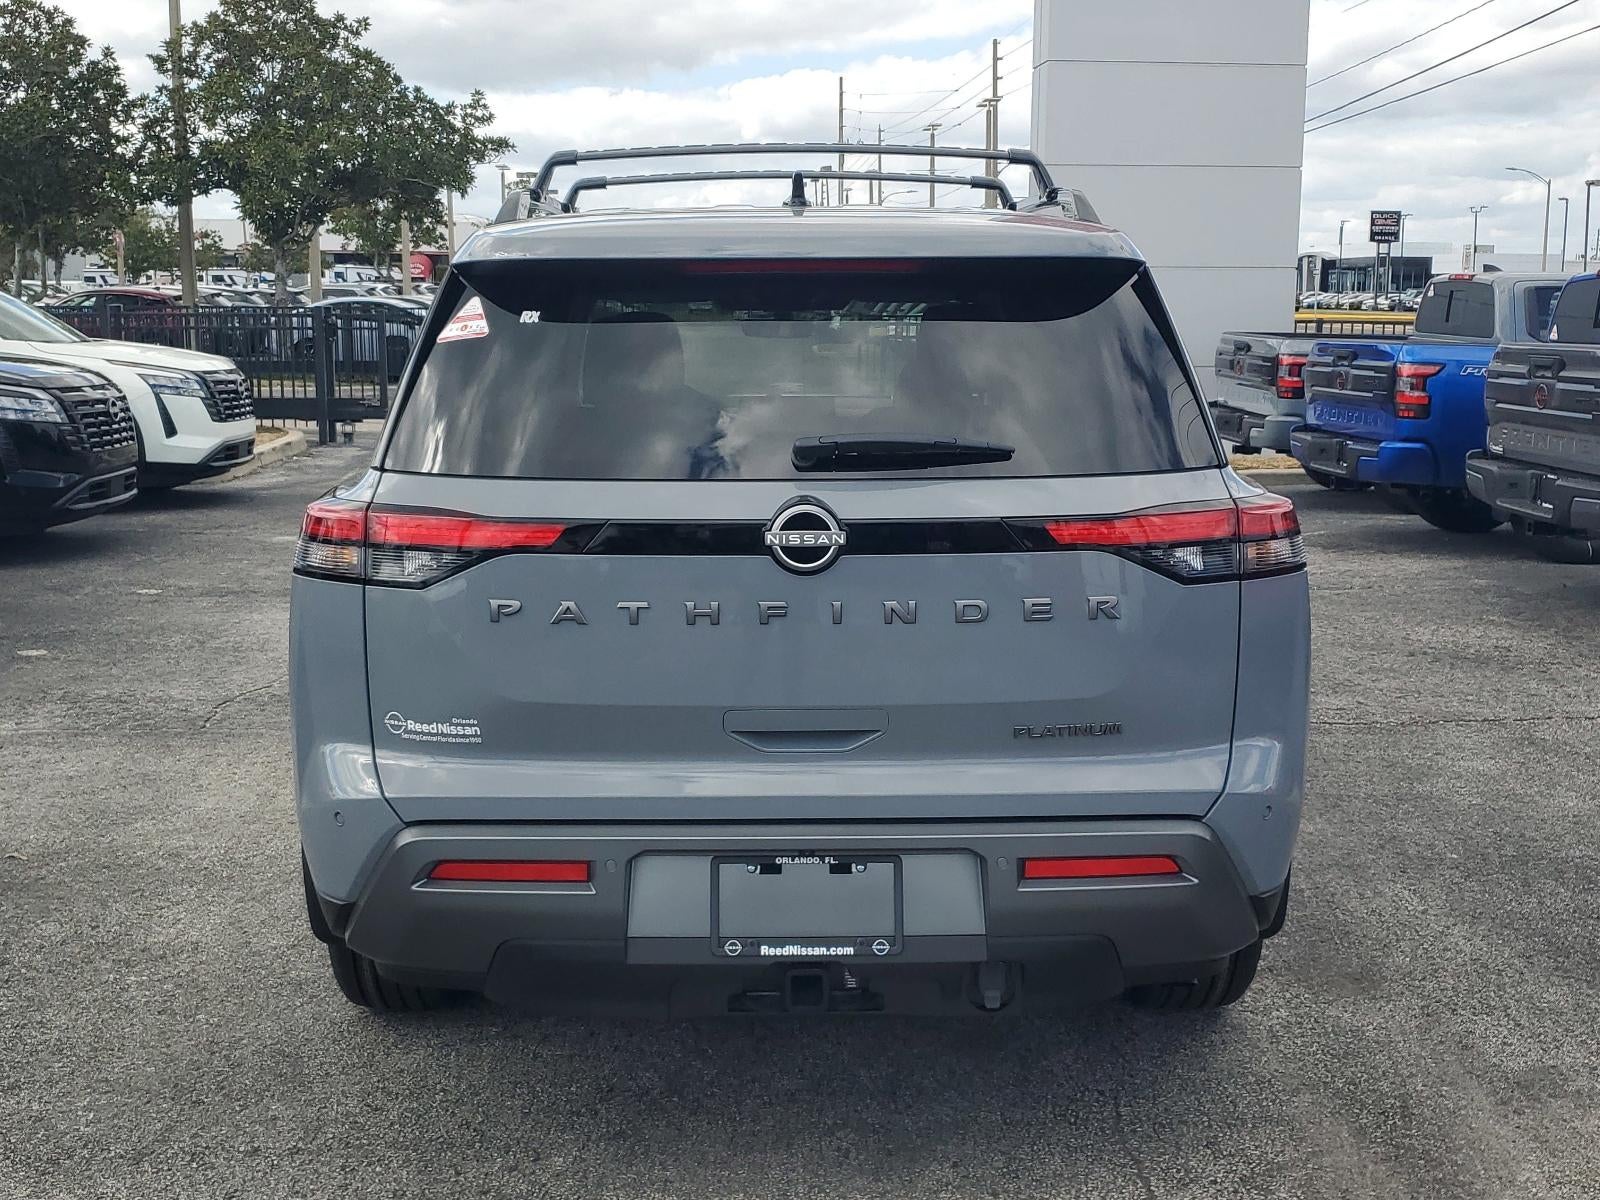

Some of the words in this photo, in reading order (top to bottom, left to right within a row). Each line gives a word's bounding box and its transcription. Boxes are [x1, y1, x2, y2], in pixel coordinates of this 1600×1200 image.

[767, 534, 844, 545] NISSAN
[488, 596, 1121, 625] PATHFINDER
[452, 717, 478, 725] Orlando
[1013, 721, 1122, 739] PLATINUM
[420, 734, 438, 742] Central
[775, 856, 823, 865] ORLANDO,
[760, 944, 854, 956] ReedNissan.com
